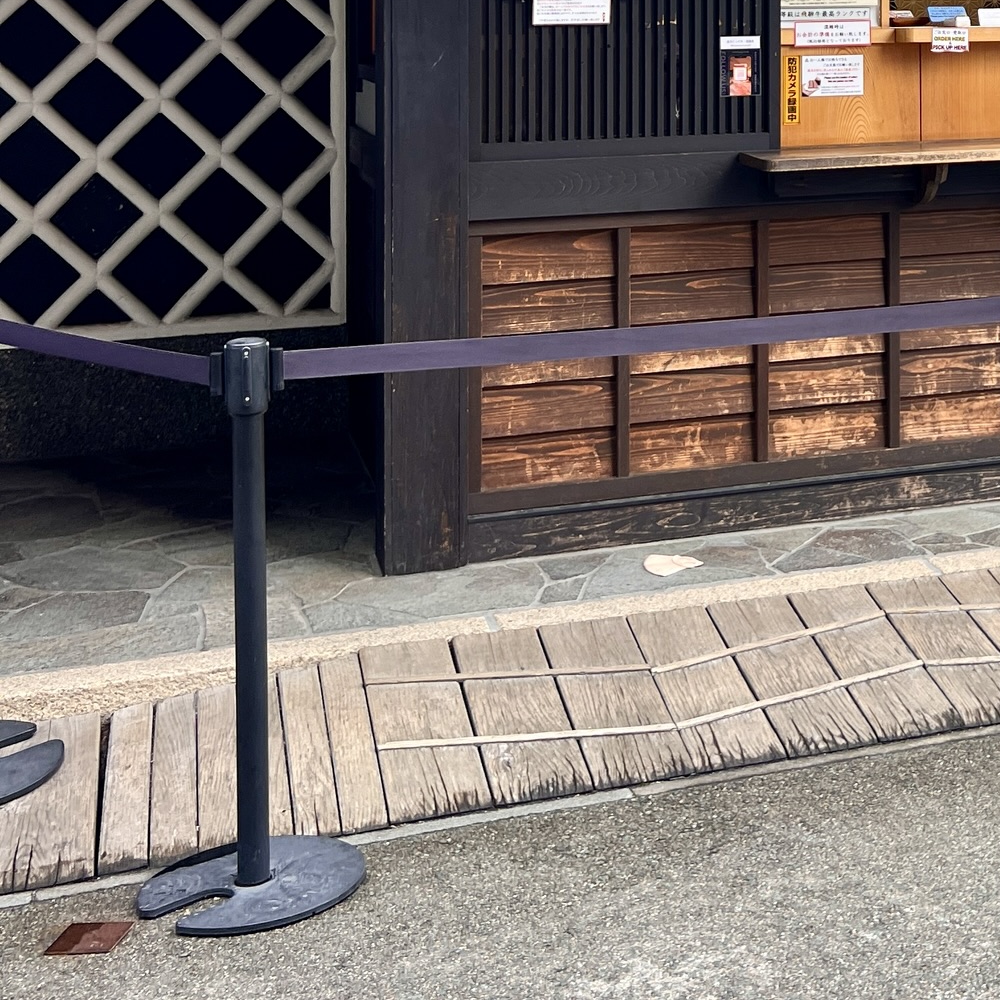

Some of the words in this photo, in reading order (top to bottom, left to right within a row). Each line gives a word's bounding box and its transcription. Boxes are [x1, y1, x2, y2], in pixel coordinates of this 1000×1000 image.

[787, 57, 797, 122] 防犯カメラ録画中
